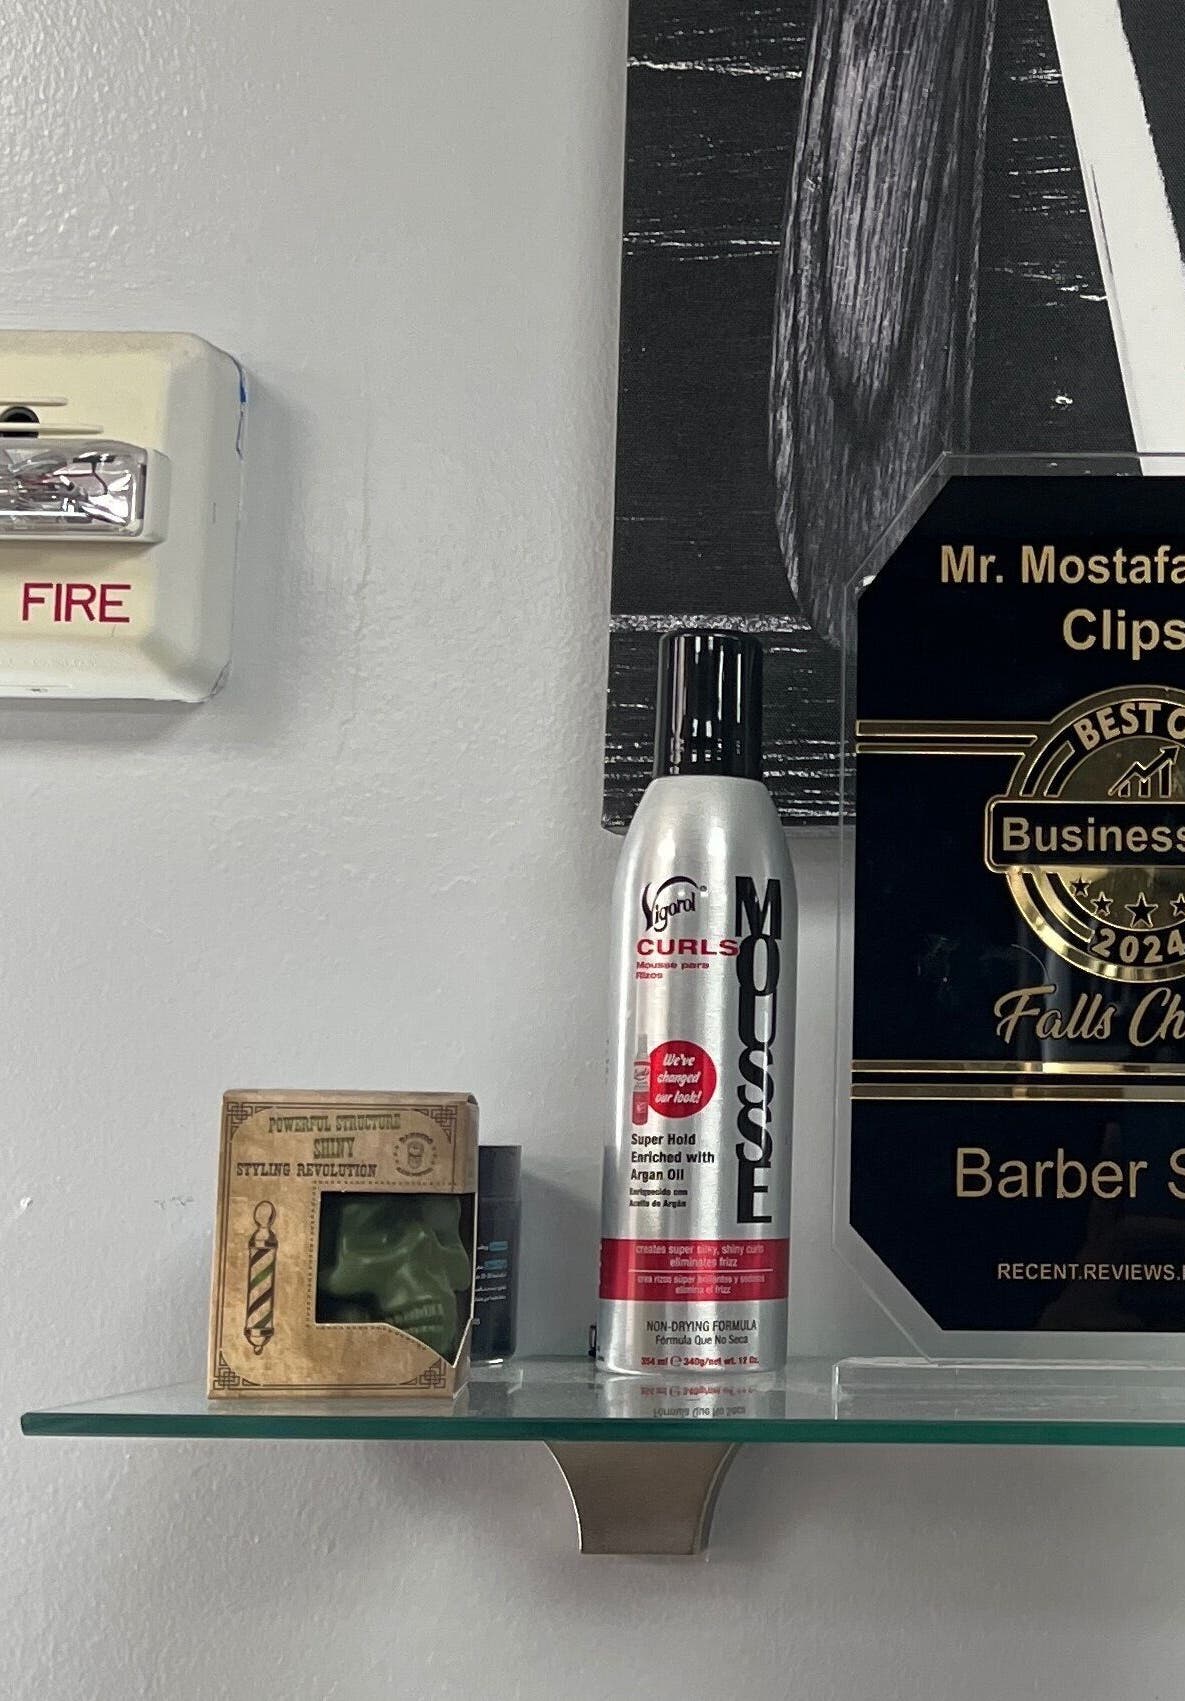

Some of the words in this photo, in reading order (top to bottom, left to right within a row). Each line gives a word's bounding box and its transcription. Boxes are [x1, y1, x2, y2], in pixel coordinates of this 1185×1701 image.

[940, 545, 1004, 584] Mr.
[21, 582, 132, 624] FIRE
[1073, 702, 1162, 751] BEST
[637, 938, 740, 956] CURLS
[636, 961, 678, 970] Mousse
[993, 983, 1115, 1045] Falls
[735, 875, 783, 1223] MOUSSE
[662, 1053, 696, 1067] We've
[657, 1069, 702, 1087] changed
[268, 1115, 332, 1133] POWERFUL
[335, 1113, 401, 1132] STRUCTURE
[313, 1137, 356, 1160] SHINY
[630, 1133, 665, 1147] Super
[667, 1133, 696, 1146] Hold
[631, 1151, 682, 1163] Enriched
[686, 1151, 715, 1163] with
[236, 1162, 291, 1177] STYLING
[296, 1162, 378, 1178] REVOLUTION
[630, 1168, 664, 1182] Argan
[667, 1168, 684, 1181] Oil
[955, 1147, 1148, 1199] Barber
[668, 1245, 694, 1256] super
[721, 1244, 745, 1256] shiny
[669, 1257, 717, 1268] eliminates
[718, 1257, 738, 1267] frizz
[646, 1320, 710, 1332] NON-DRYING
[712, 1319, 757, 1332] FORMULA
[694, 1335, 713, 1345] Que
[715, 1335, 728, 1345] No
[728, 1335, 749, 1344] Seca
